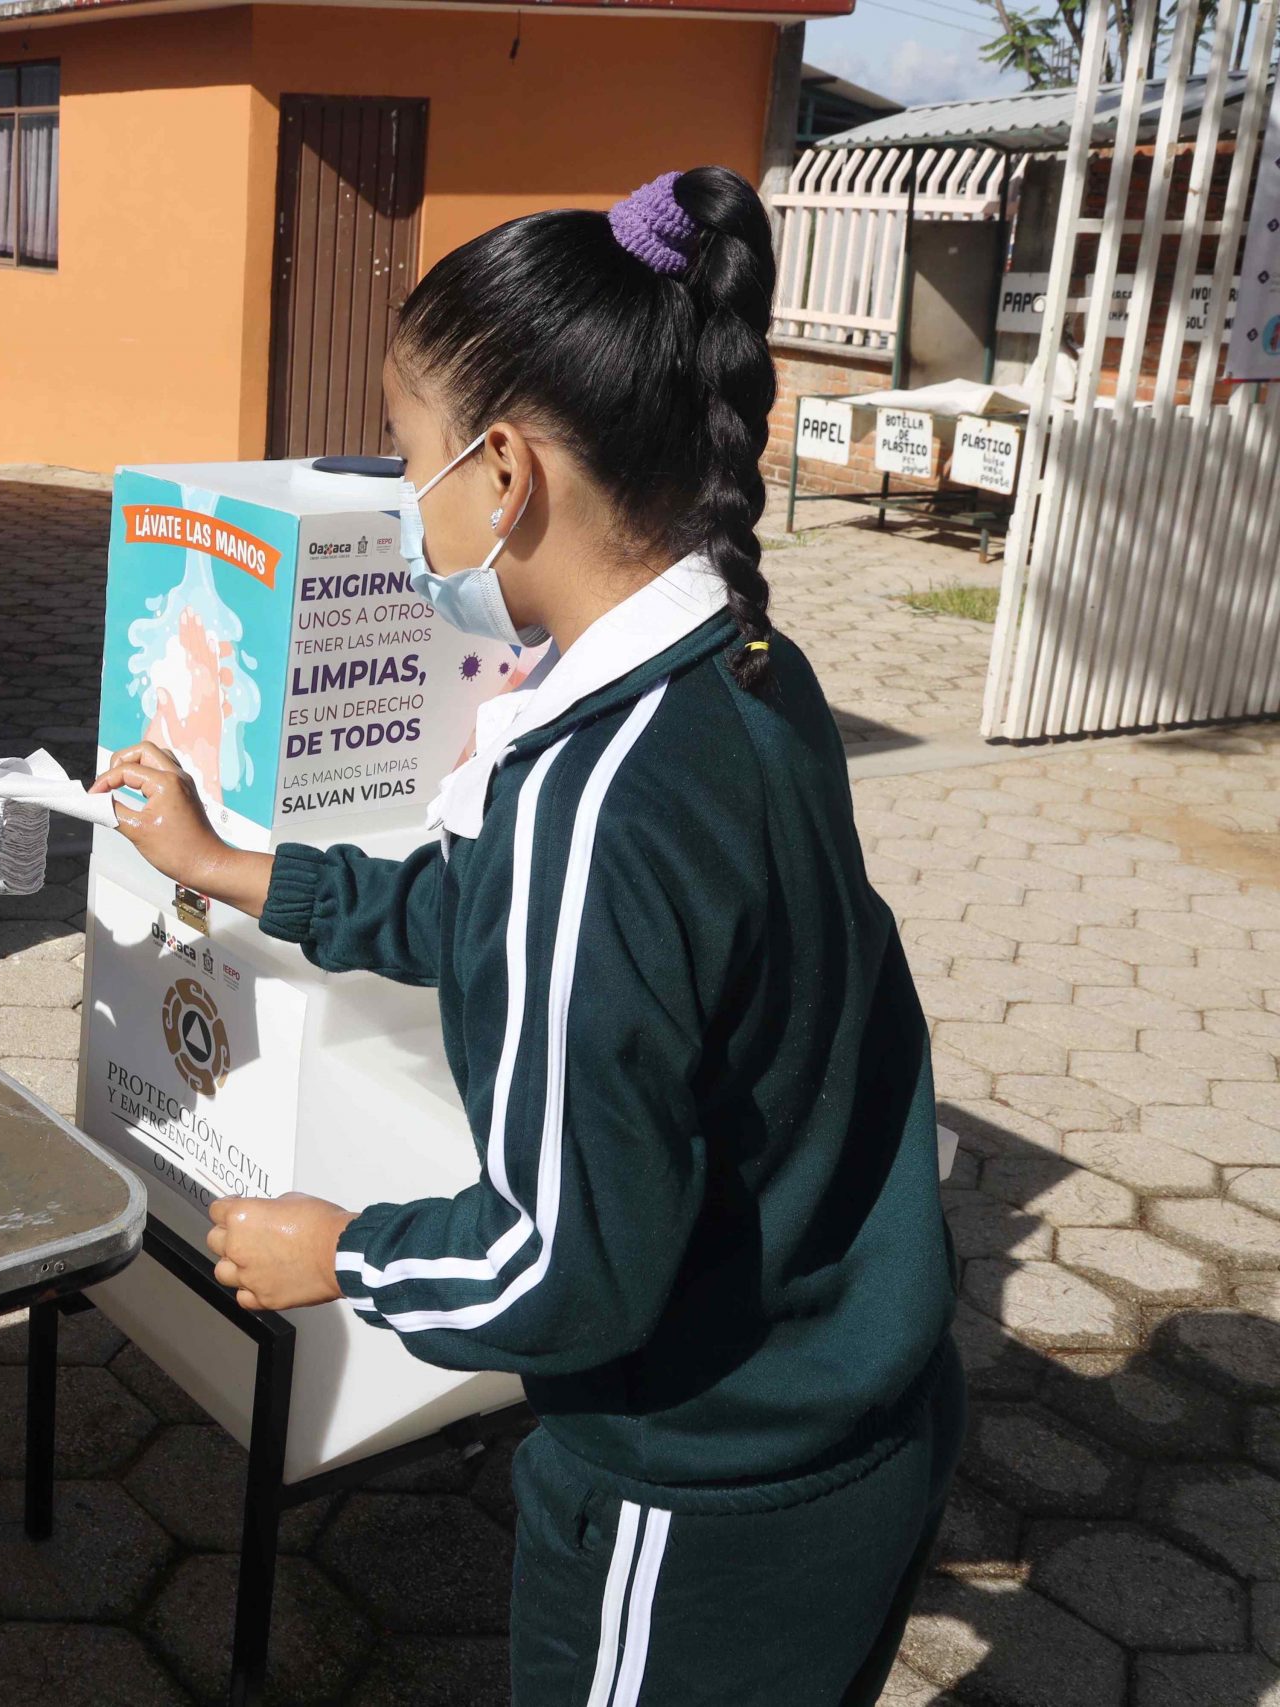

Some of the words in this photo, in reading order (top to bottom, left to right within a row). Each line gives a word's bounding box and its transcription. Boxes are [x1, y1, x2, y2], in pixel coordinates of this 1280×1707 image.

[802, 418, 845, 444] PAPEL
[886, 414, 924, 430] BOTELLA
[898, 429, 909, 441] DE
[961, 428, 1012, 456] PLÁSTICO
[135, 508, 182, 540] LÁVATE
[186, 519, 211, 547] LAS
[215, 528, 266, 575] MANOS
[309, 542, 352, 555] Oaxaca
[300, 571, 415, 601] EXIGIRN
[298, 608, 352, 630] UNOS
[355, 607, 369, 625] A
[373, 602, 435, 623] OTROS
[295, 636, 344, 655] TENER
[347, 633, 374, 650] LAS
[378, 628, 432, 646] MANOS
[292, 654, 426, 696] LIMPIAS,
[288, 709, 309, 726] ES
[314, 704, 338, 722] UN
[343, 694, 424, 718] DERECHO
[286, 731, 323, 759] DE
[330, 718, 421, 751] TODOS
[283, 773, 308, 789] LAS
[312, 765, 362, 784] MANOS
[365, 757, 418, 777] LIMPIAS
[282, 787, 355, 814] SALVAN
[360, 779, 416, 802] VIDAS
[223, 963, 240, 981] IEEPO
[107, 1060, 223, 1153] PROTECCIÓN
[227, 1145, 272, 1197] CIVIL
[107, 1085, 116, 1103] Y
[120, 1094, 208, 1168] EMERGENCIA
[212, 1157, 258, 1198] ESCOL
[153, 1152, 210, 1207] OAXAC
